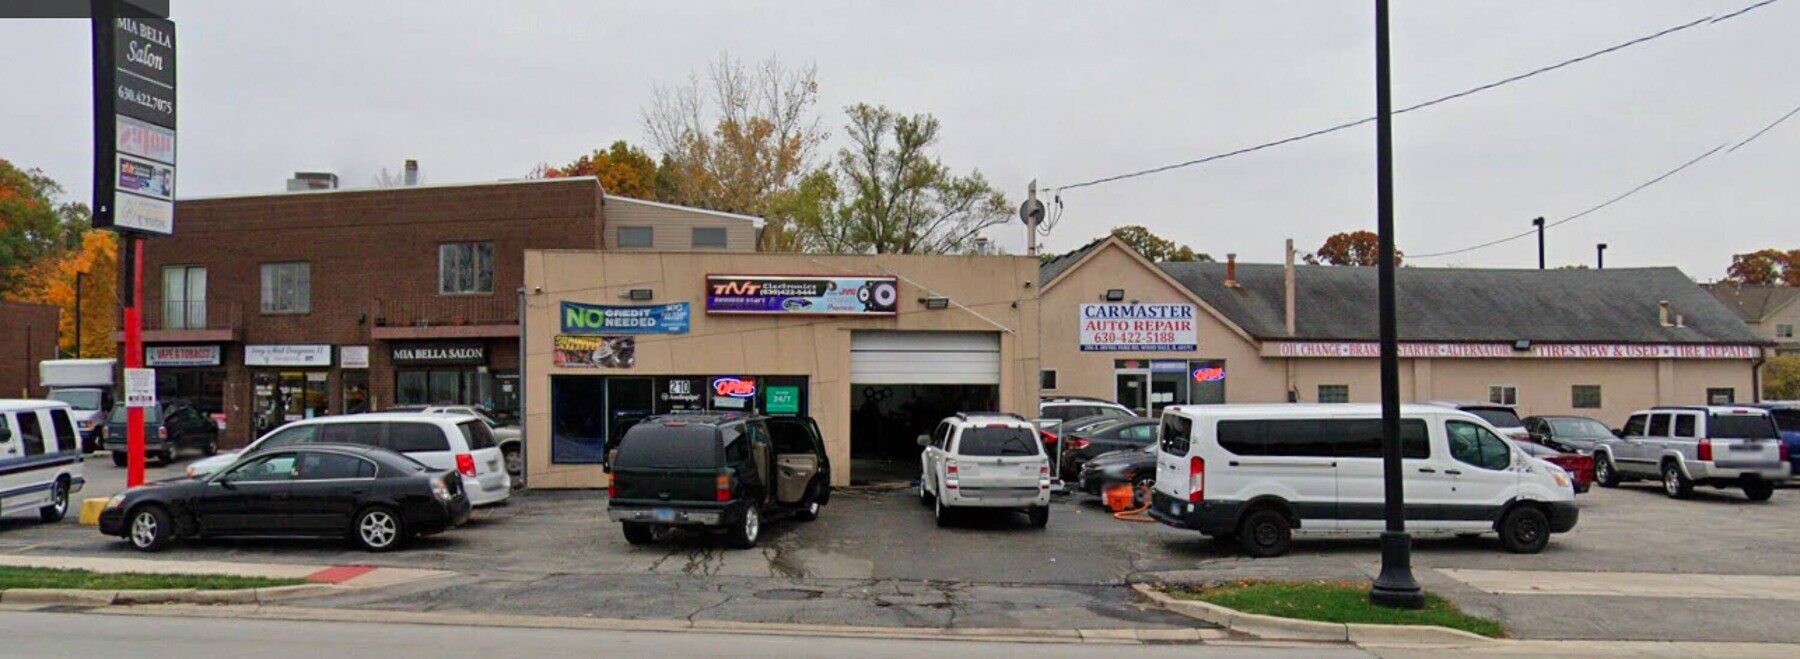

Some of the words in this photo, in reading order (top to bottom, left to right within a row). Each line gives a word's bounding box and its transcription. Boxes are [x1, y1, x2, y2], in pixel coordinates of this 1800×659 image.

[117, 18, 138, 35] MIA
[140, 23, 171, 48] BELLA
[126, 40, 163, 70] Salon
[118, 84, 172, 114] 630.422.7075
[714, 281, 761, 295] TNT
[566, 306, 605, 329] NO
[605, 309, 651, 318] CREDIT
[1085, 305, 1192, 319] CARMASTER
[605, 318, 656, 328] NEEDED
[1085, 320, 1129, 332] AUTO
[1134, 320, 1192, 332] REPAIR
[1094, 332, 1175, 344] 630-422-5188
[157, 349, 174, 359] VAPE
[393, 349, 414, 359] MIA
[415, 349, 447, 359] BELLA
[448, 348, 484, 359] SALON
[1281, 343, 1297, 356] OIL
[1300, 343, 1341, 356] CHANGE
[1398, 344, 1440, 356] STARTER
[1448, 344, 1512, 356] ALTERNATOR
[1540, 344, 1577, 357] TIRES
[1580, 344, 1609, 357] NEW
[1614, 344, 1623, 357] &
[1625, 344, 1660, 357] USED
[1673, 345, 1700, 357] TIRE
[1704, 345, 1751, 357] REPAIR
[670, 380, 690, 394] 210
[717, 379, 755, 396] OPEN
